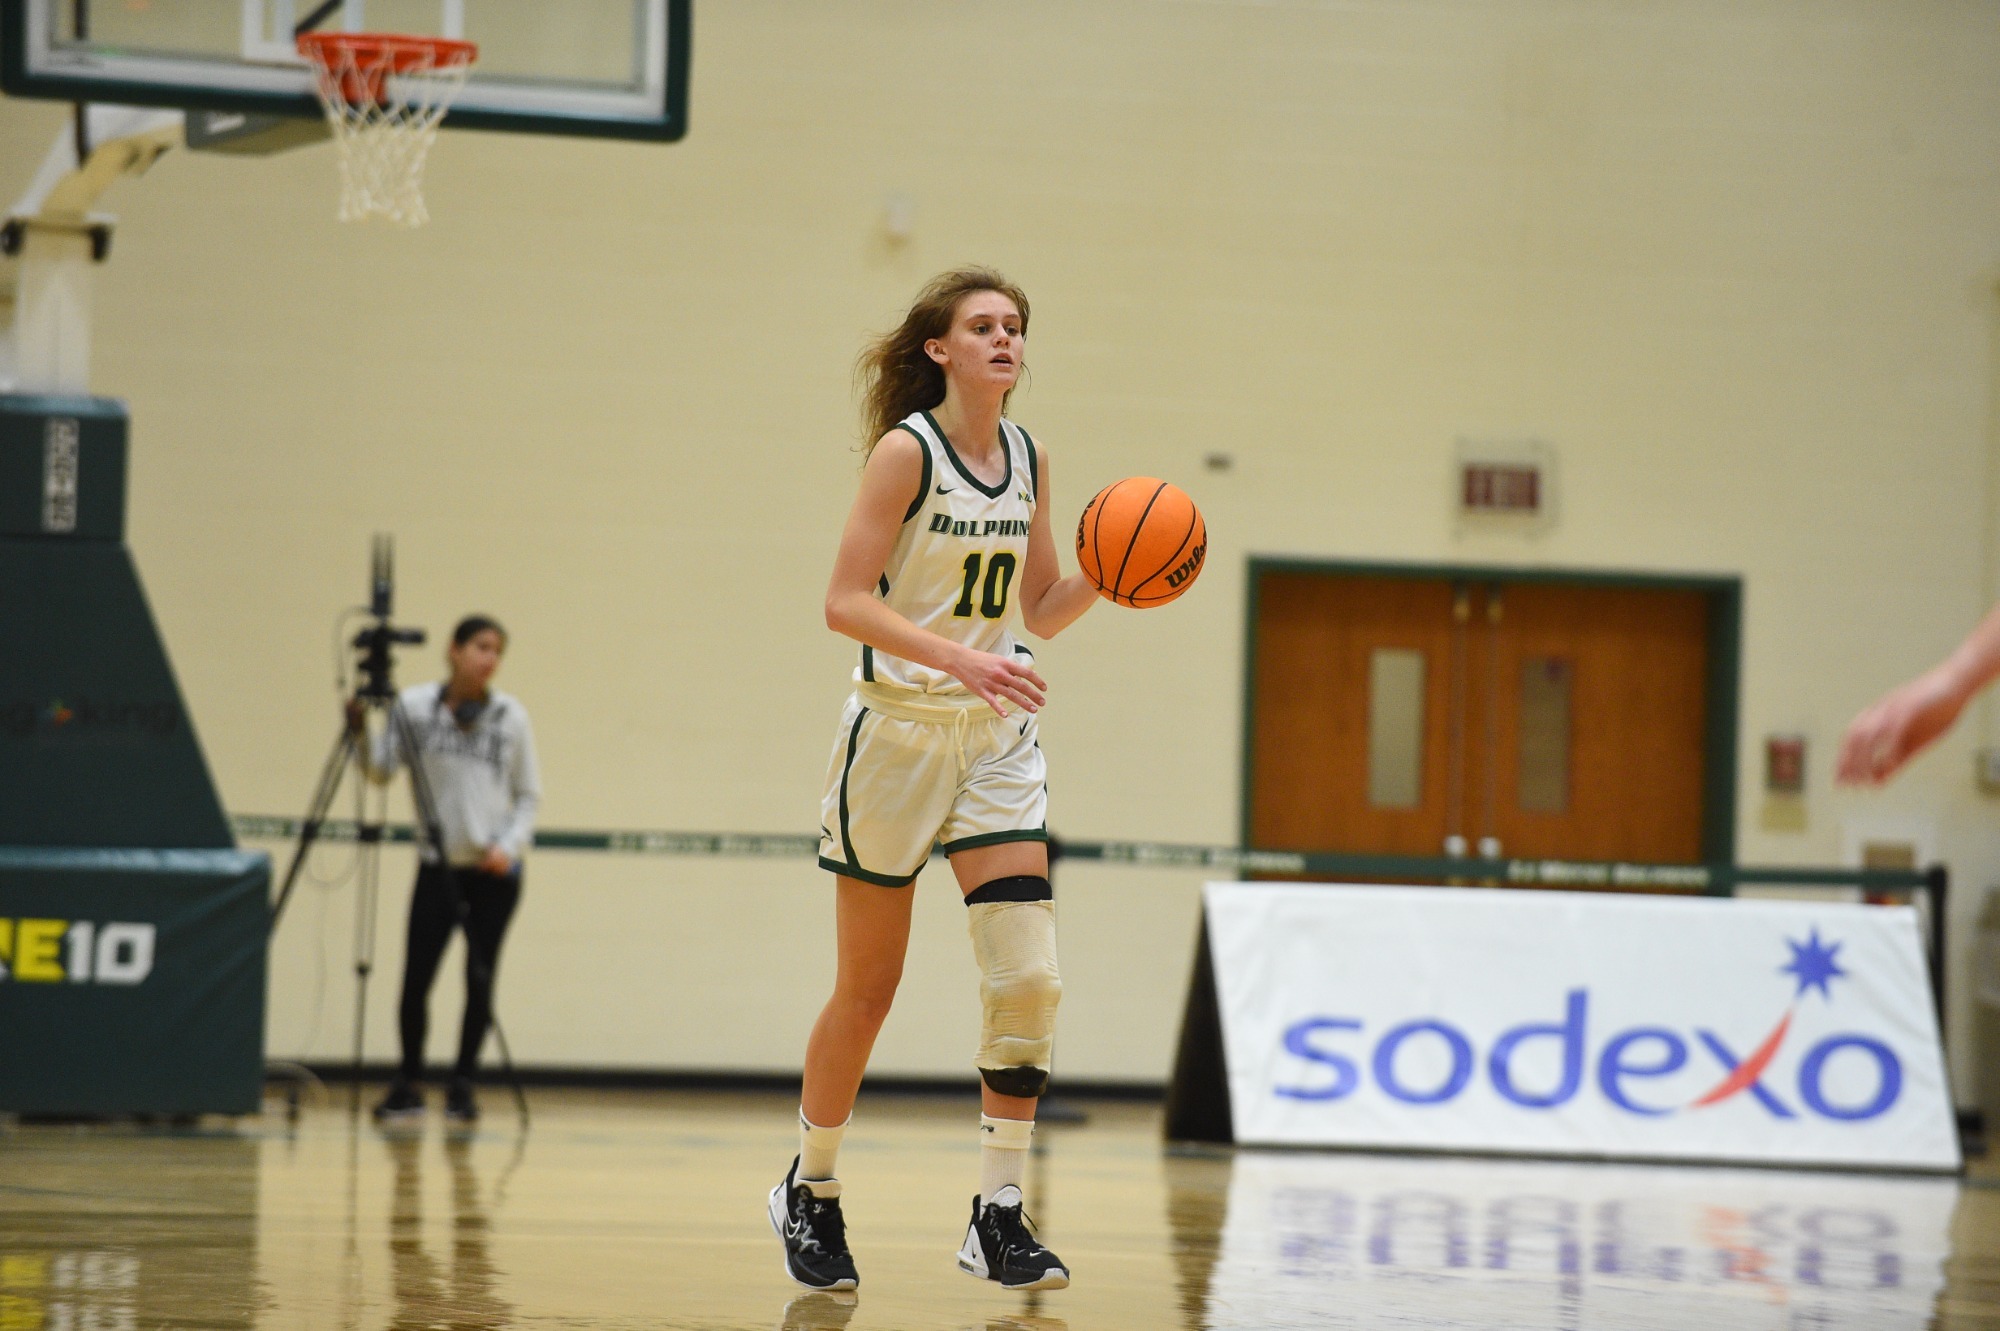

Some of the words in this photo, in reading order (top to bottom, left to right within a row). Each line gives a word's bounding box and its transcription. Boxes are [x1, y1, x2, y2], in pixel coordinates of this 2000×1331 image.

[928, 512, 1030, 537] DOLPHIN
[952, 551, 1017, 620] 10
[1273, 987, 1904, 1121] sodexo
